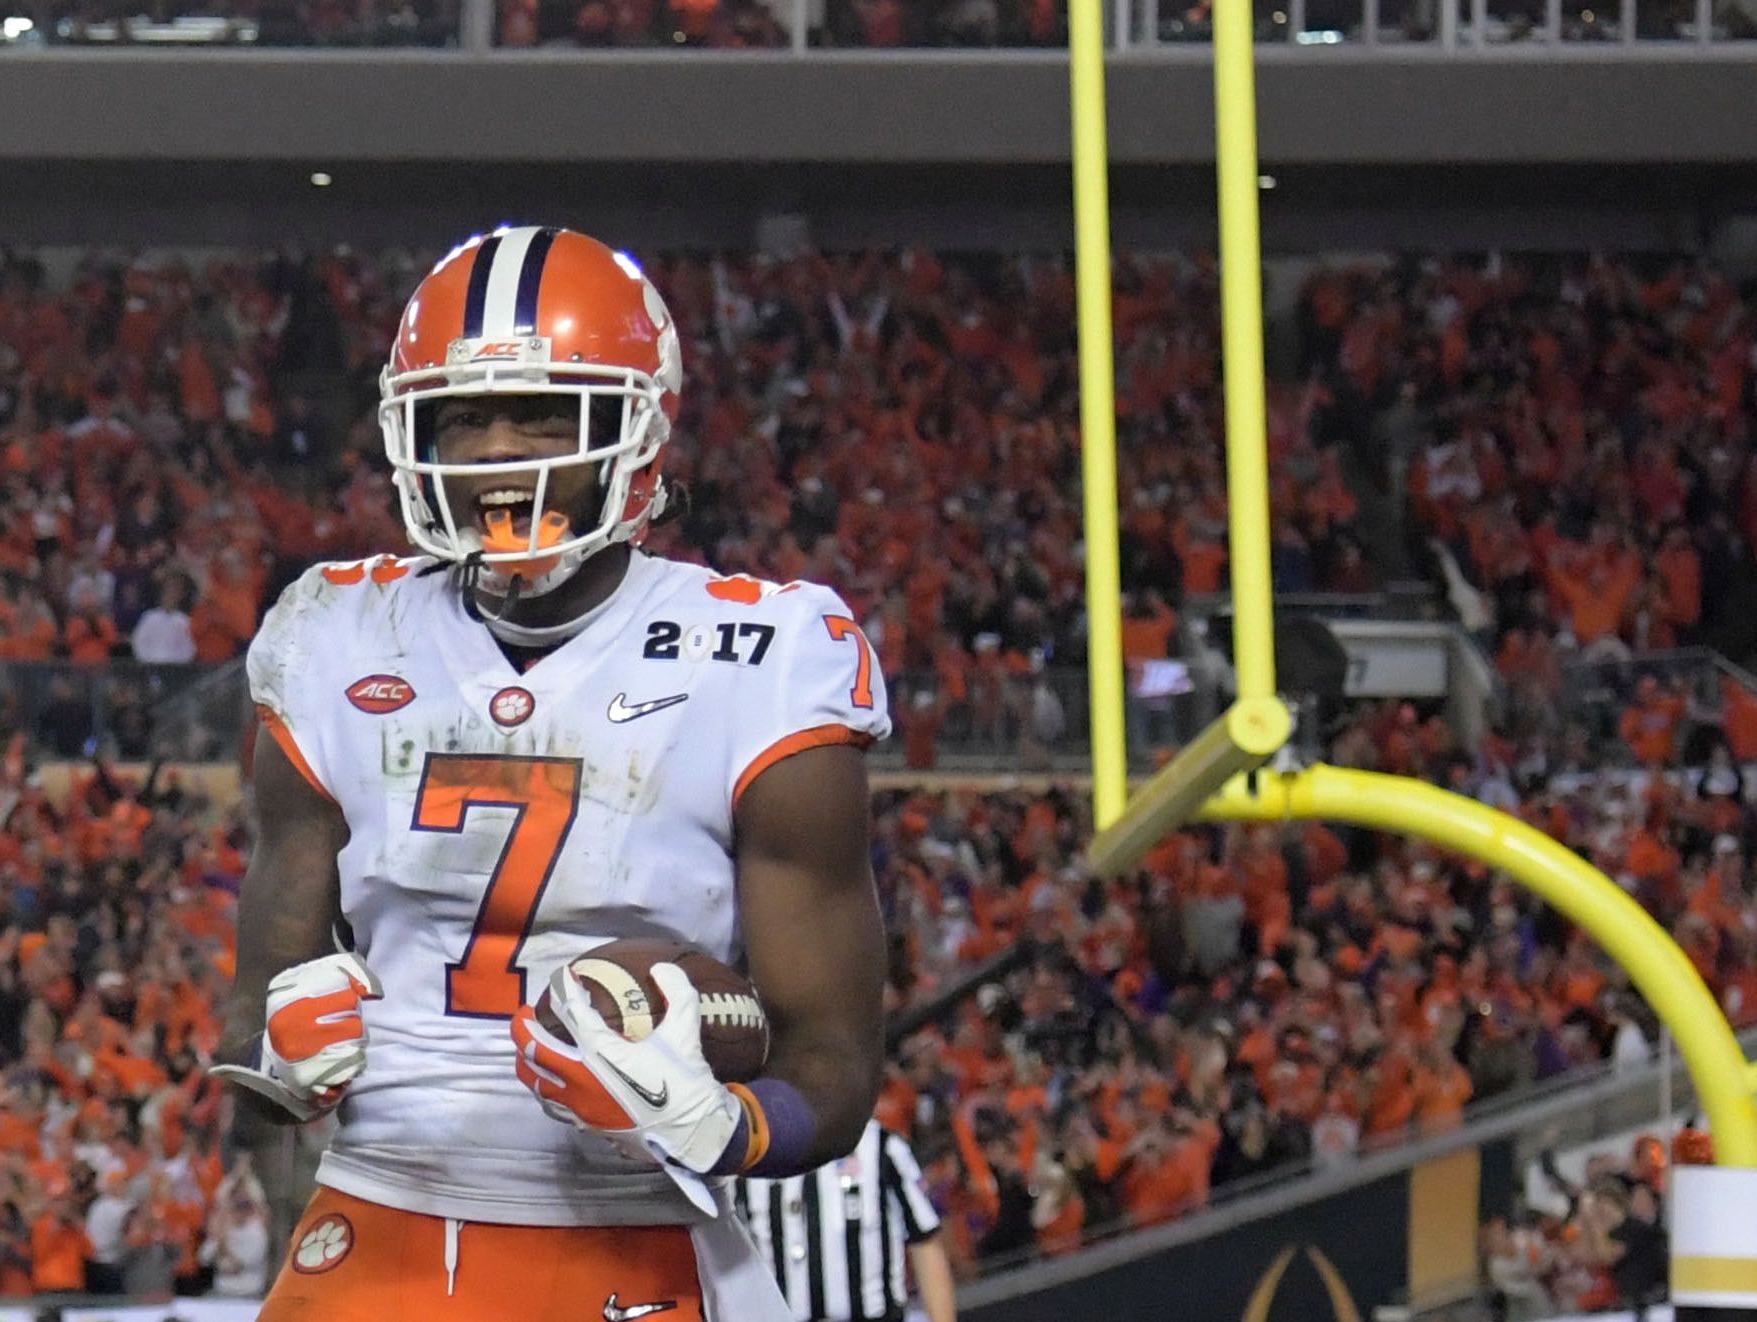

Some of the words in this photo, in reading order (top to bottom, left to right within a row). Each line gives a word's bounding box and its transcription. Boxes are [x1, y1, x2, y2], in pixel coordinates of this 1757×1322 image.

[473, 342, 523, 357] ACC
[642, 619, 777, 666] 2017
[822, 613, 874, 710] 7
[354, 682, 409, 700] ACC
[411, 752, 584, 1020] 7
